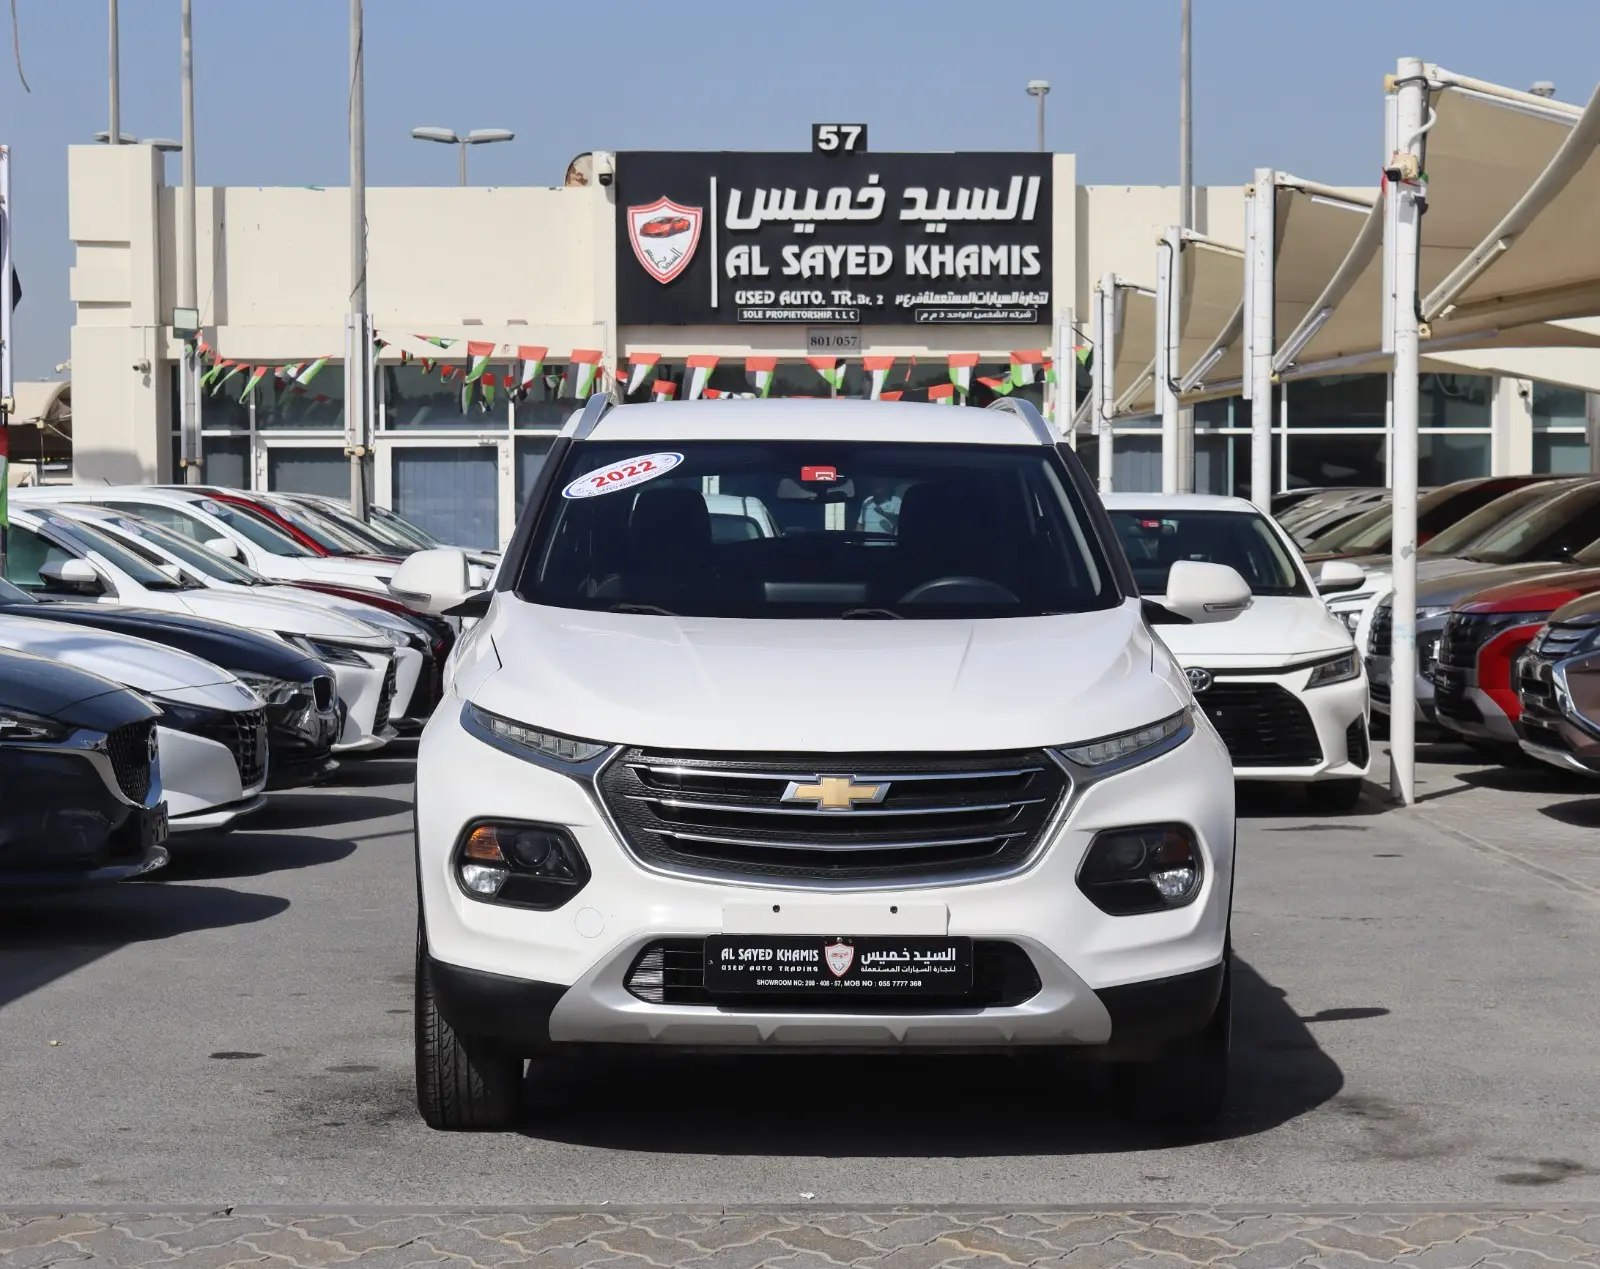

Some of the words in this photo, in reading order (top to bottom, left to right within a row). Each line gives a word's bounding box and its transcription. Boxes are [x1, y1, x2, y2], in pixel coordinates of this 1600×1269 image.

[817, 125, 862, 150] 57
[725, 173, 886, 233] خميس
[900, 175, 1041, 233] السيد
[725, 244, 770, 278] AL
[782, 244, 892, 279] SAYED
[906, 244, 1041, 279] KHAMIS
[735, 290, 776, 305] USED
[779, 290, 826, 306] AUTO.
[877, 295, 884, 305] 2
[742, 310, 763, 319] SOLE
[810, 336, 858, 347] 801/057
[590, 460, 657, 488] 2022
[721, 948, 736, 961] AL
[738, 948, 774, 962] SAYED
[776, 949, 819, 962] KHAMIS
[860, 947, 910, 965] خميس
[913, 947, 956, 965] السيد
[779, 965, 819, 973] TRADING
[901, 965, 932, 974] السيارات
[933, 965, 956, 974] لتجارة
[756, 979, 793, 987] SHOWROOM
